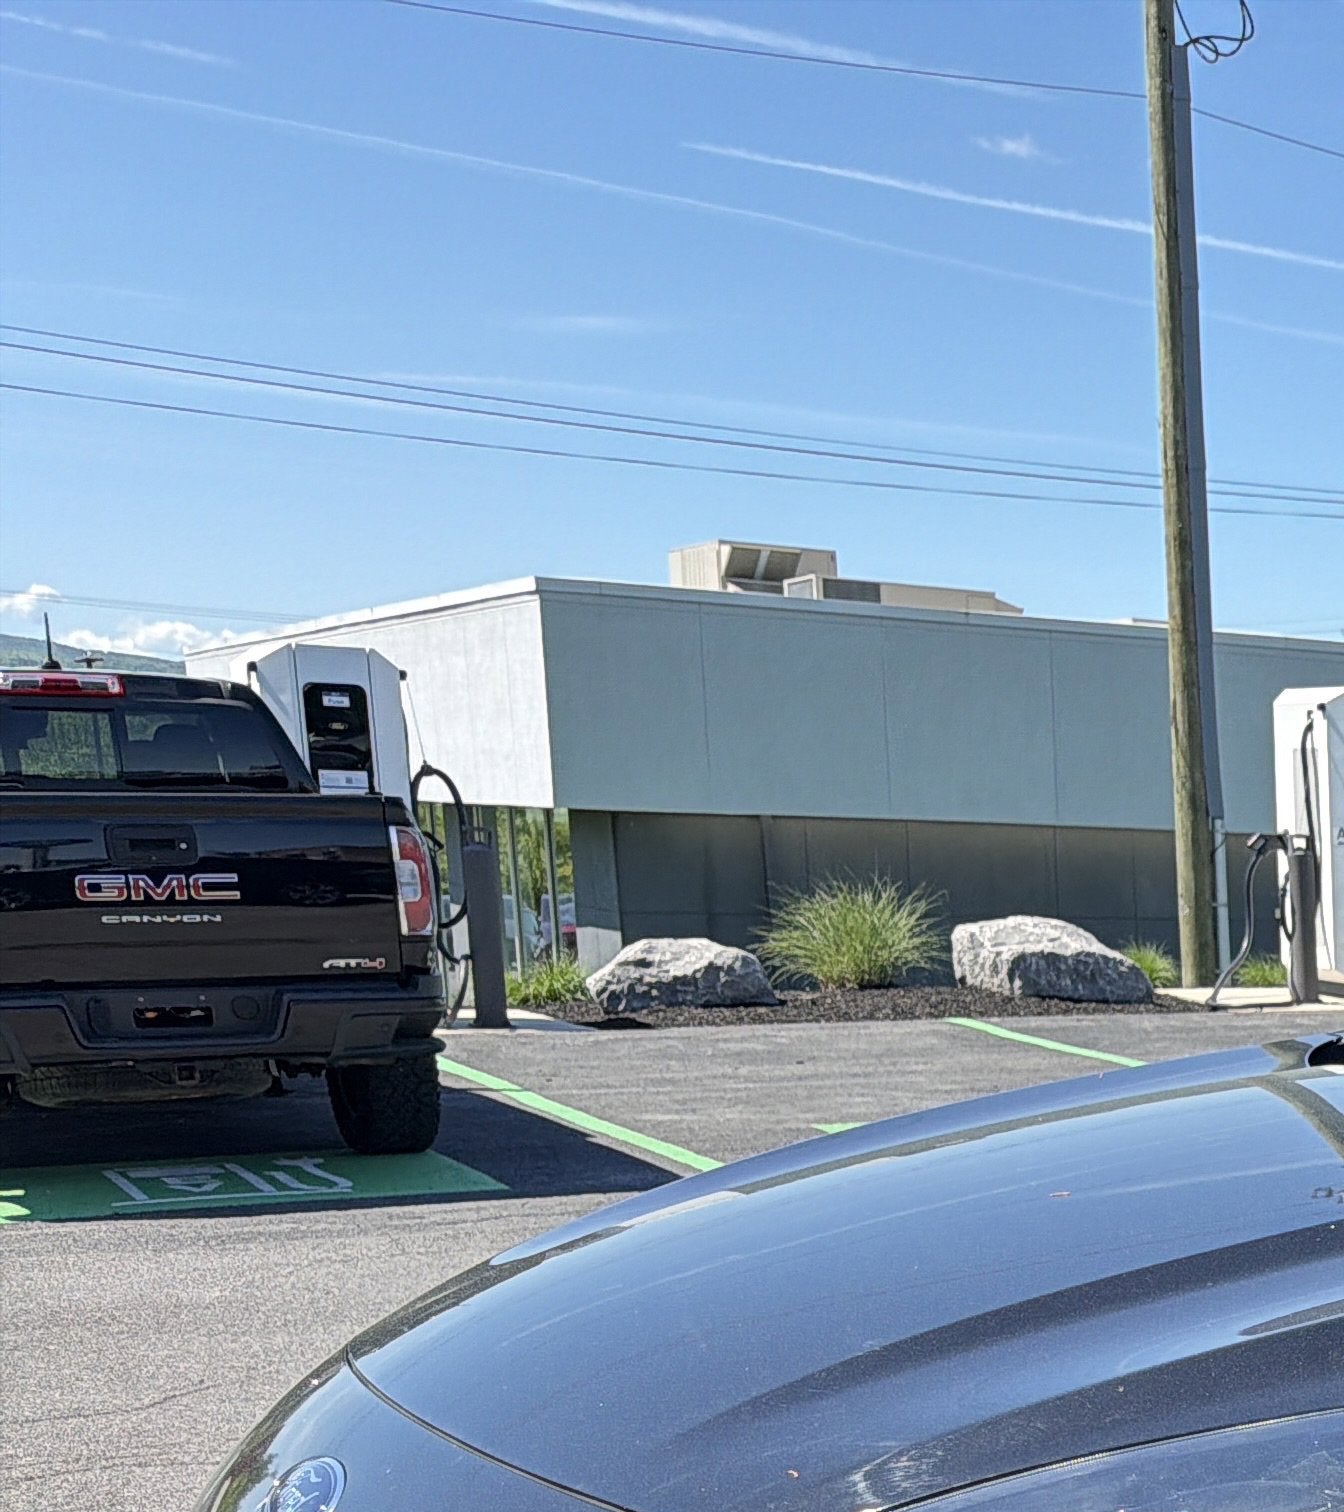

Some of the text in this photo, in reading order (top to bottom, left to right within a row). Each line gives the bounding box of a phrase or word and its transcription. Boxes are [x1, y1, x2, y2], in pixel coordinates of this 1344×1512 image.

[75, 873, 241, 901] GMC
[101, 914, 222, 924] CANYON
[323, 957, 386, 970] AT4
